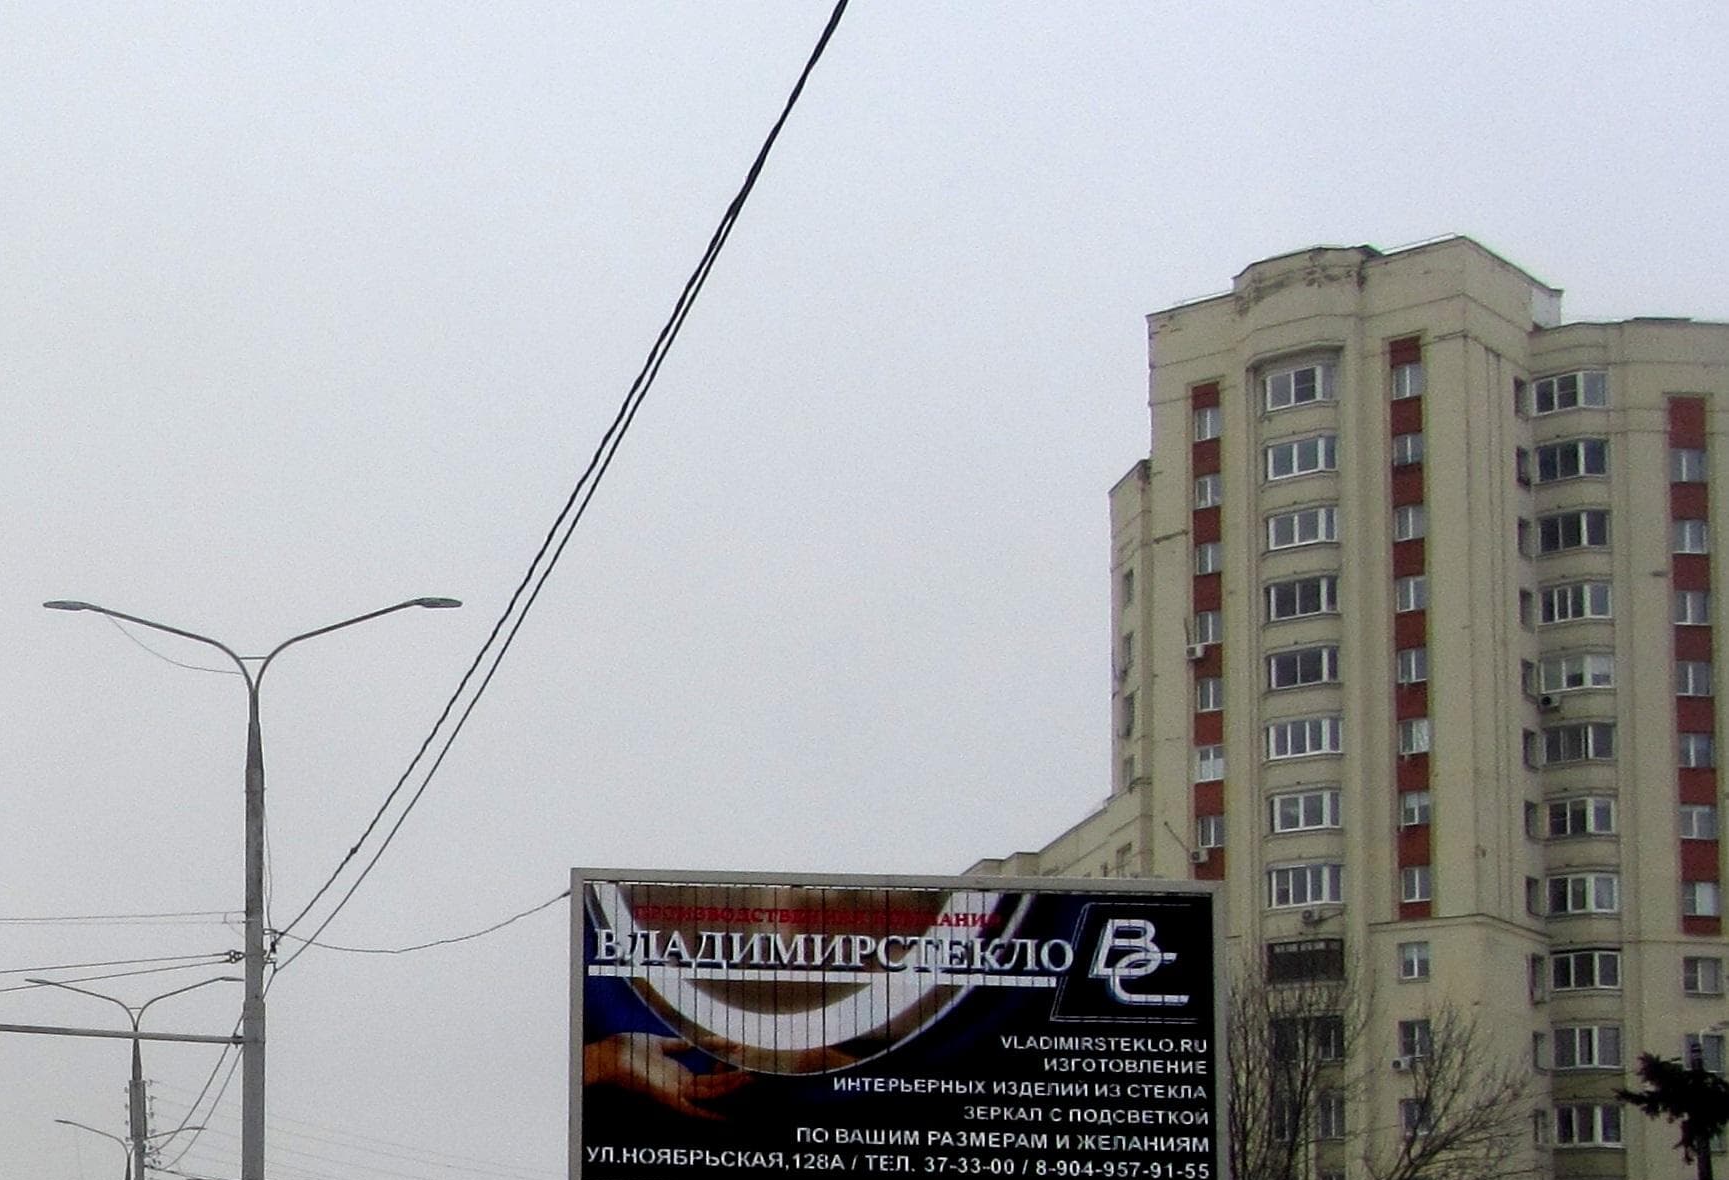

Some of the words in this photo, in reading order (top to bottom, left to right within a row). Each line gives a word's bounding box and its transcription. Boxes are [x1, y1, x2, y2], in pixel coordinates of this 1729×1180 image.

[594, 928, 1074, 972] ВЛАДИМИРСТЕКЛО
[1000, 1035, 1208, 1054] VLADIMIRSTEKLO.RU
[1043, 1057, 1208, 1075] ИЗГОТОВЛЕНИЕ
[832, 1076, 987, 1095] ИНТЕРЬЕРНЫХ
[993, 1080, 1089, 1098] ИЗДЕЛИЙ
[1094, 1083, 1122, 1098] ИЗ
[1126, 1083, 1208, 1099] СТЕКЛА
[963, 1105, 1044, 1122] ЗЕРКАЛ
[1049, 1107, 1062, 1122] С
[1069, 1107, 1209, 1126] ПОДСВЕТКОЙ
[796, 1127, 829, 1144] ПО
[835, 1128, 920, 1146] ВАШИМ
[927, 1130, 1048, 1150] РАЗМЕРАМ
[1055, 1134, 1071, 1149] И
[1076, 1134, 1210, 1152] ЖЕЛАНИЯМ
[864, 1154, 917, 1172] ТЕЛ.
[924, 1156, 1015, 1175] 37-33-00
[1021, 1159, 1029, 1175] /
[1035, 1159, 1210, 1179] 8-904-957-91-55
